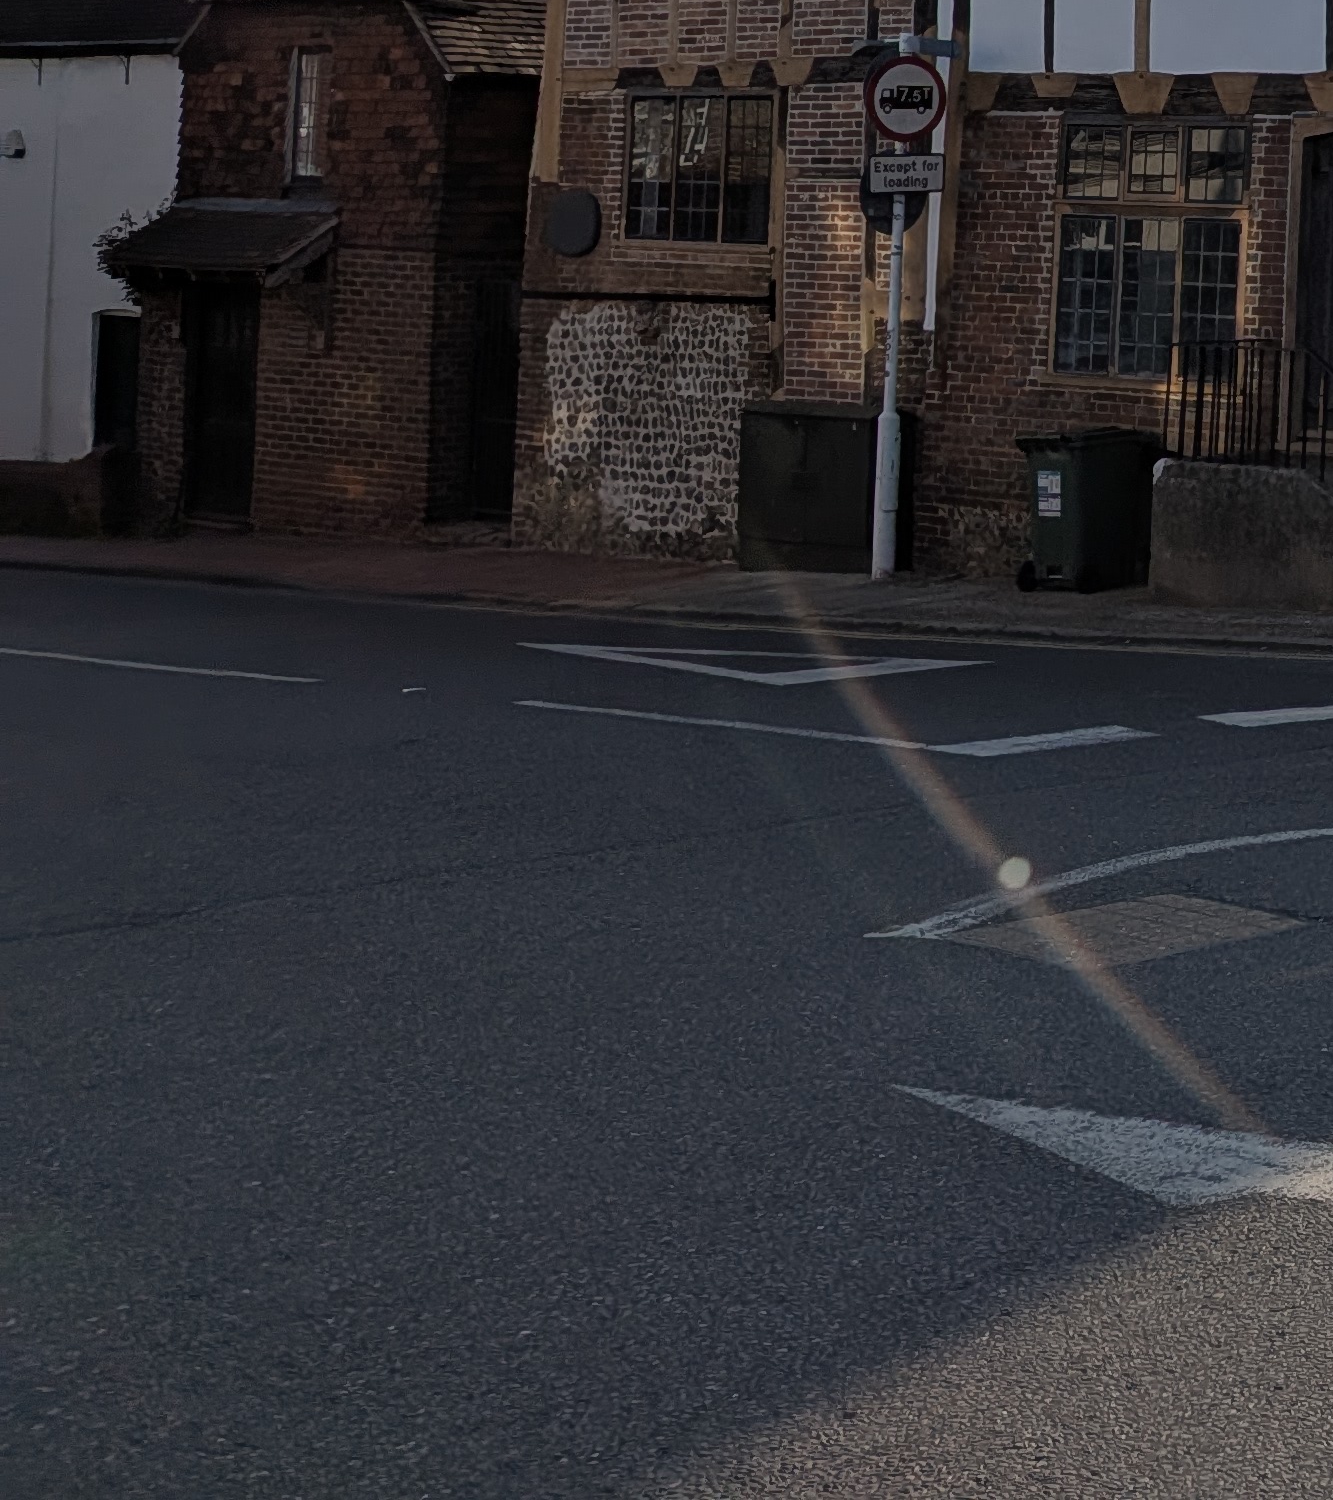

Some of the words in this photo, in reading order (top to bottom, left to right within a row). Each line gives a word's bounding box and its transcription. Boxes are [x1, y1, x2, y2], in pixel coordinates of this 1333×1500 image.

[899, 87, 931, 102] 7.5T
[874, 160, 917, 175] Except
[922, 160, 940, 172] for
[883, 175, 929, 189] loading
